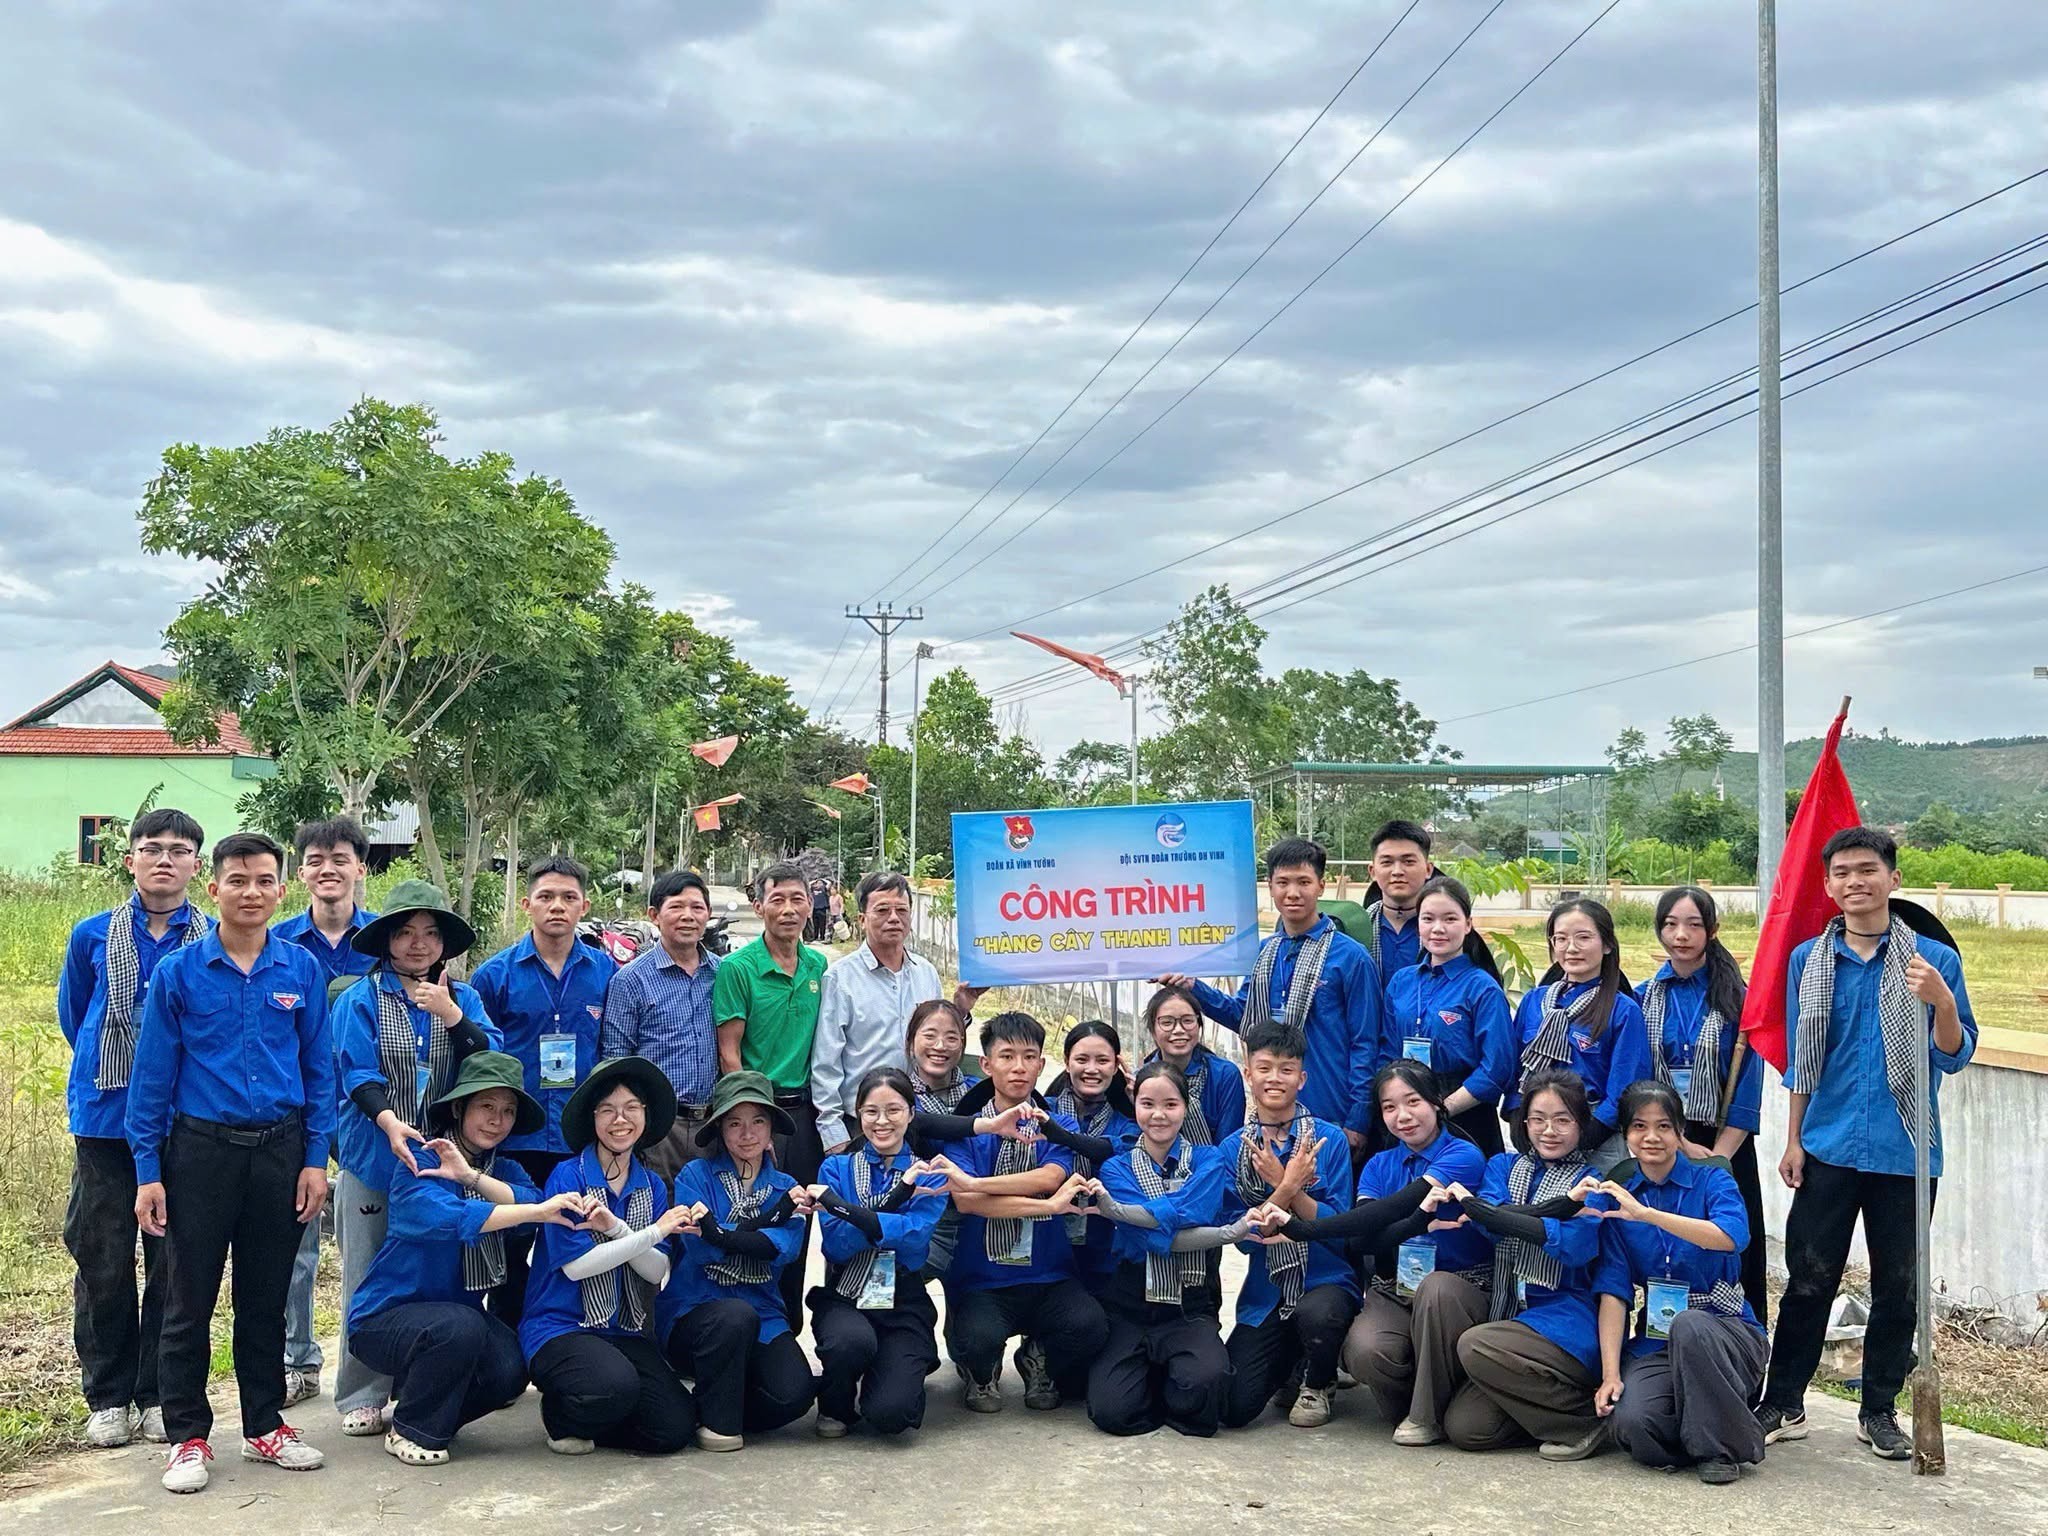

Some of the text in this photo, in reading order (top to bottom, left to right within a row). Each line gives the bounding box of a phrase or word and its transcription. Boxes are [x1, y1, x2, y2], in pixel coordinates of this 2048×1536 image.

[1209, 850, 1225, 860] VINH
[999, 878, 1206, 922] CÔNG TRÌNH
[1050, 927, 1095, 952] CÂY
[1101, 927, 1171, 949] THANH
